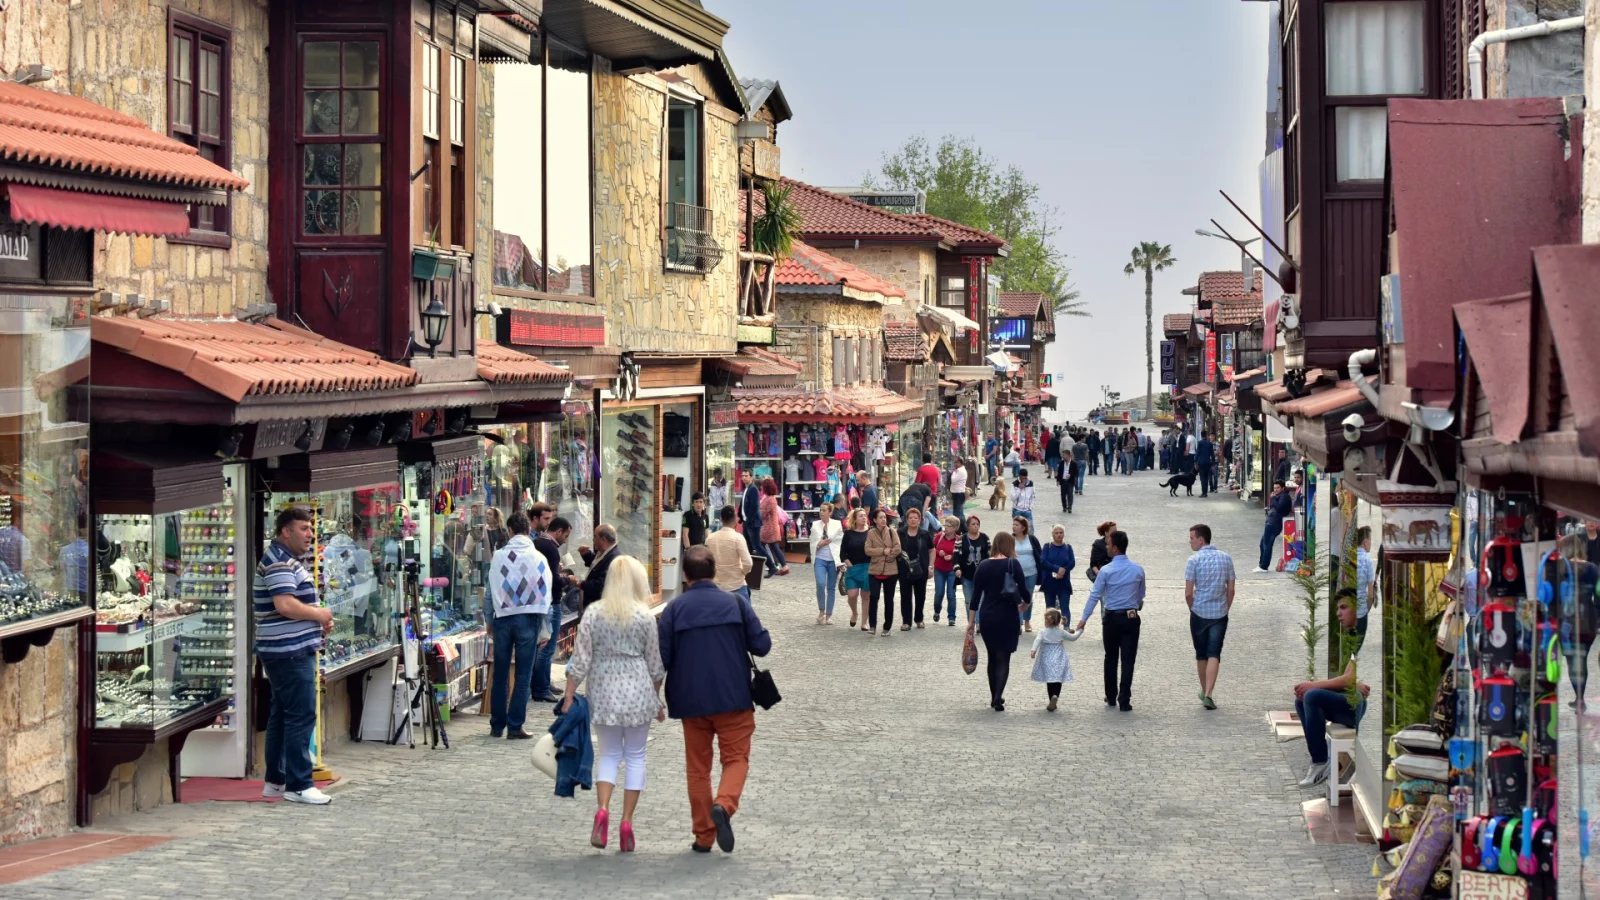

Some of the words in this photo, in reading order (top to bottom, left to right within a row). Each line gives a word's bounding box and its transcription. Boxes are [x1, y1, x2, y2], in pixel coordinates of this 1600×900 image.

[874, 196, 915, 205] LOUNGE
[0, 234, 29, 258] MAD
[1461, 873, 1527, 898] BEATS
